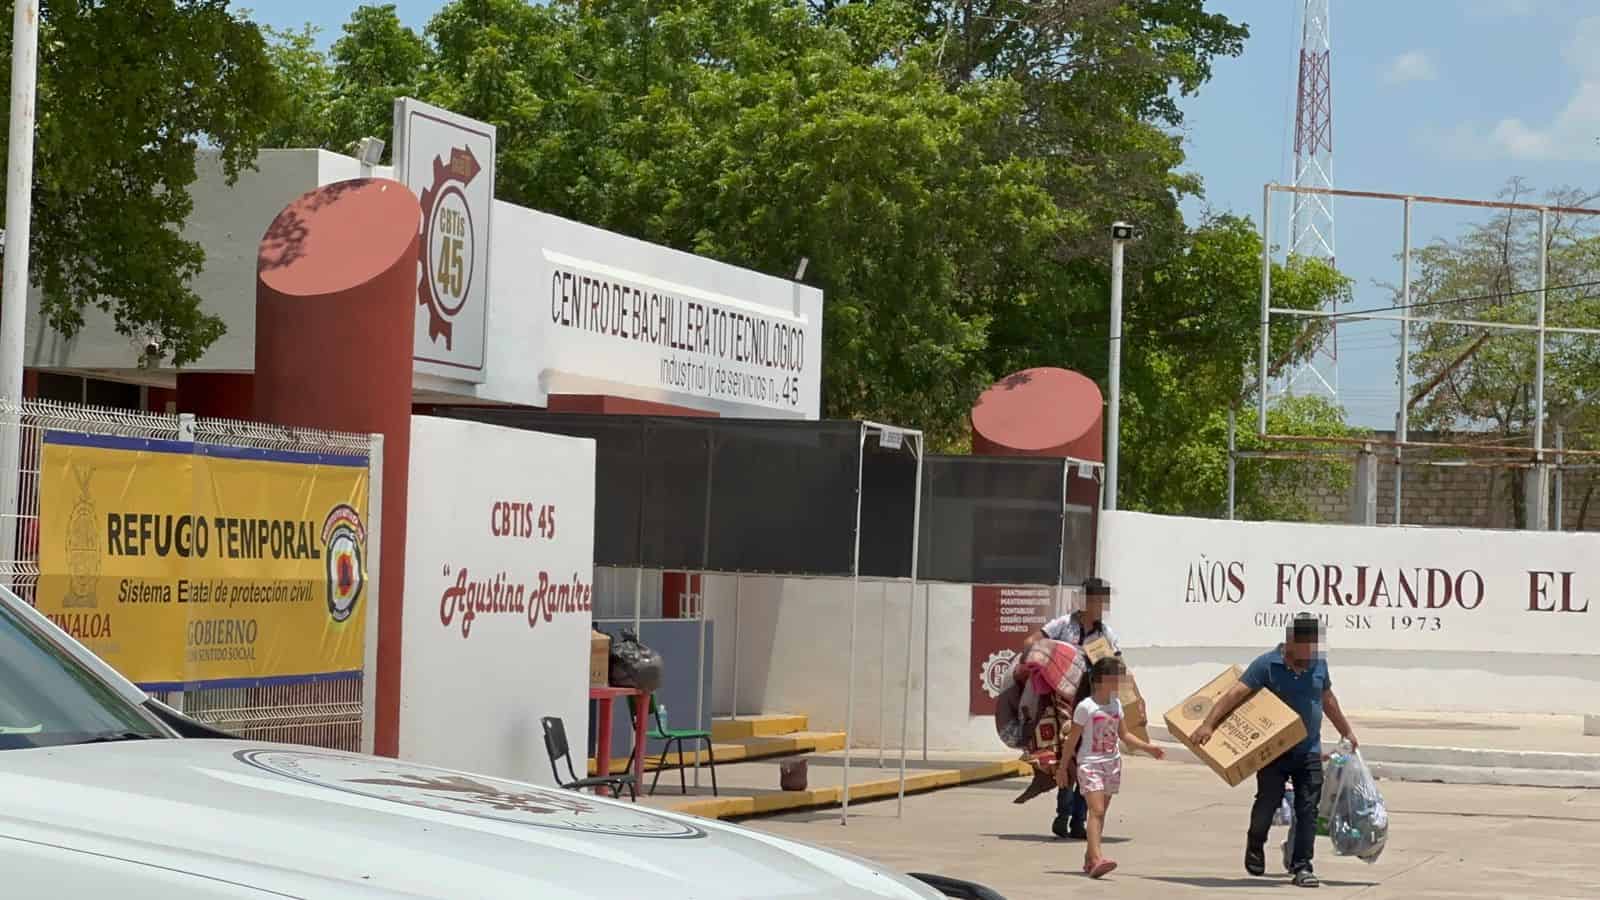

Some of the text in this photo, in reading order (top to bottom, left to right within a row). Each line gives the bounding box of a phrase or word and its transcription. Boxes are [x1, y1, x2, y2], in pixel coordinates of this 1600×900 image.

[437, 235, 464, 298] 45
[551, 269, 804, 373] CENTRO DE BACHILLERATO TECNOLOGICO
[715, 364, 727, 394] de
[728, 369, 766, 401] servicios
[781, 376, 799, 406] 45
[107, 513, 208, 558] REFUGIO
[214, 517, 321, 560] TEMPORAL
[492, 501, 555, 540] CBTIS 45
[118, 579, 171, 603] Sistema
[215, 579, 228, 603] de
[229, 579, 289, 609] protección
[527, 571, 592, 628] Ramire
[1185, 553, 1590, 613] AÑOS FORJANDO EL
[1345, 614, 1373, 630] SIN
[1391, 615, 1441, 631] 1973
